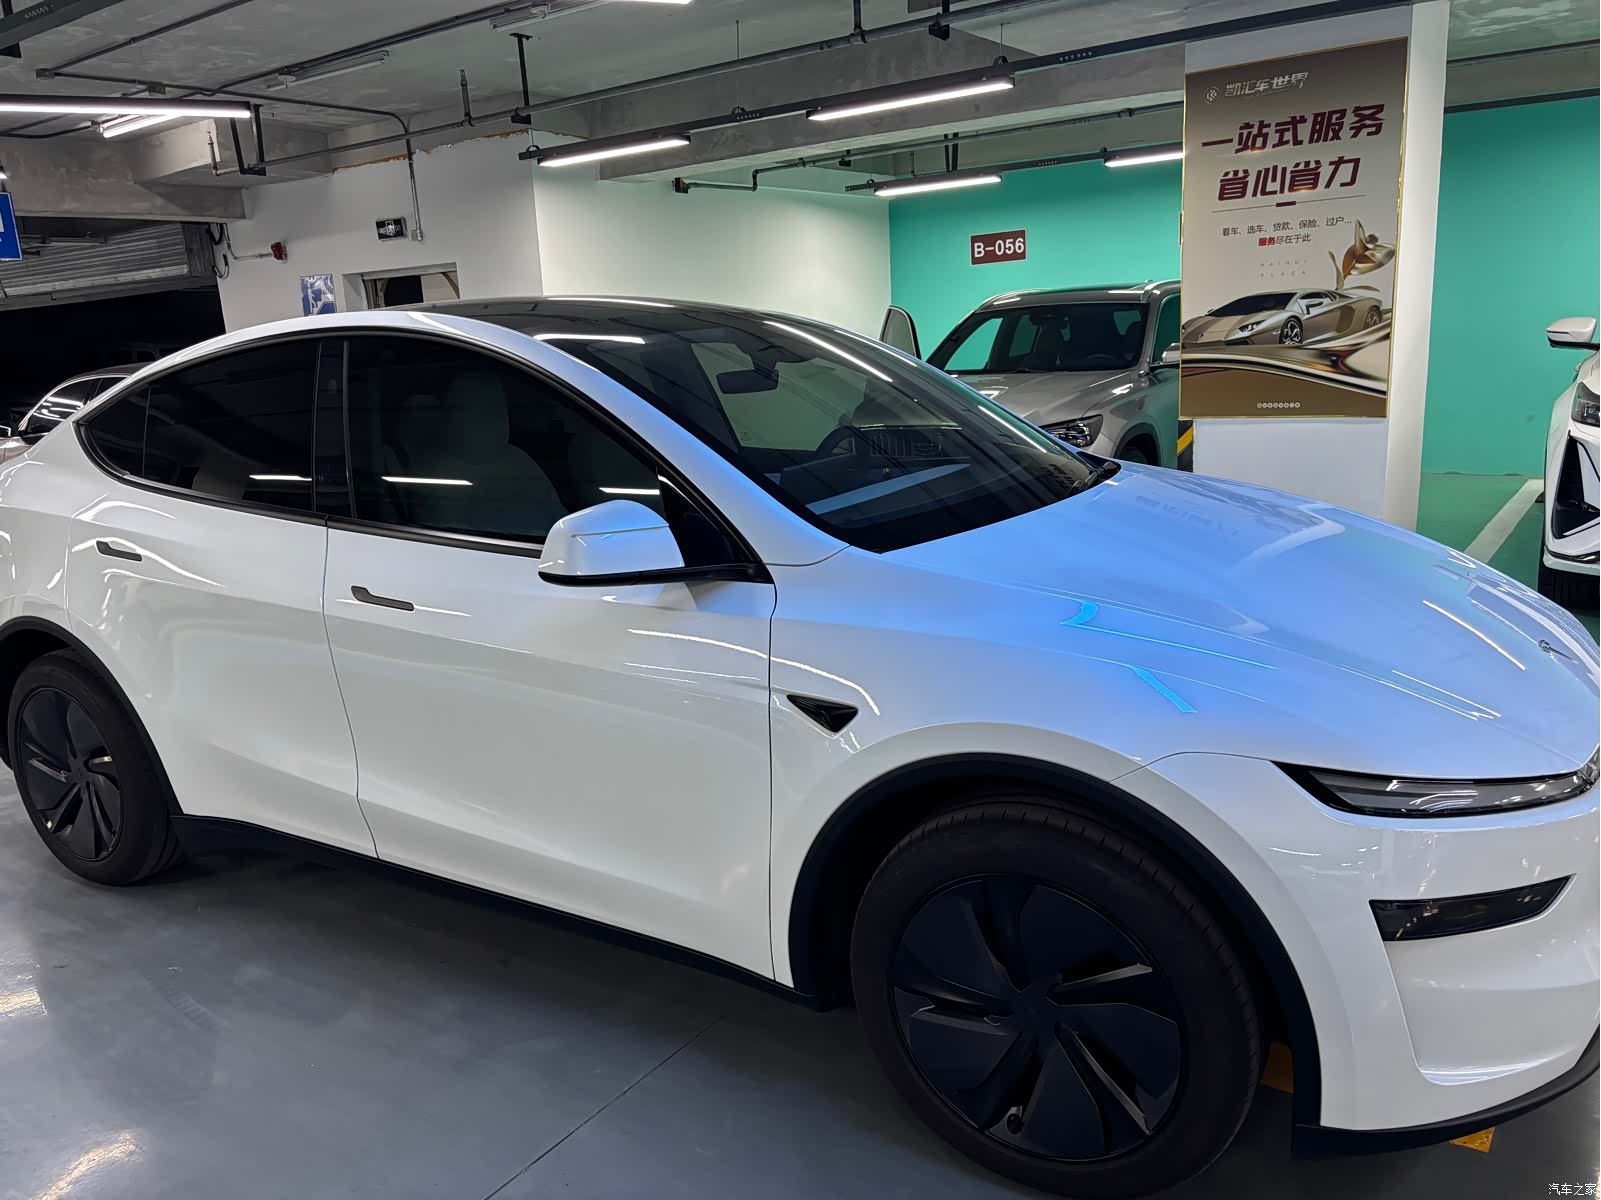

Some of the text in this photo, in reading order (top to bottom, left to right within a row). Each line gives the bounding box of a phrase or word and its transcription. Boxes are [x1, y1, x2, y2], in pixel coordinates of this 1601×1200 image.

[1225, 72, 1309, 97] 凯汇车世界
[1201, 103, 1386, 155] 一站式服务
[1217, 155, 1361, 201] 省心省力
[974, 238, 1025, 258] B-056
[1258, 233, 1312, 247] 服务尽在于此
